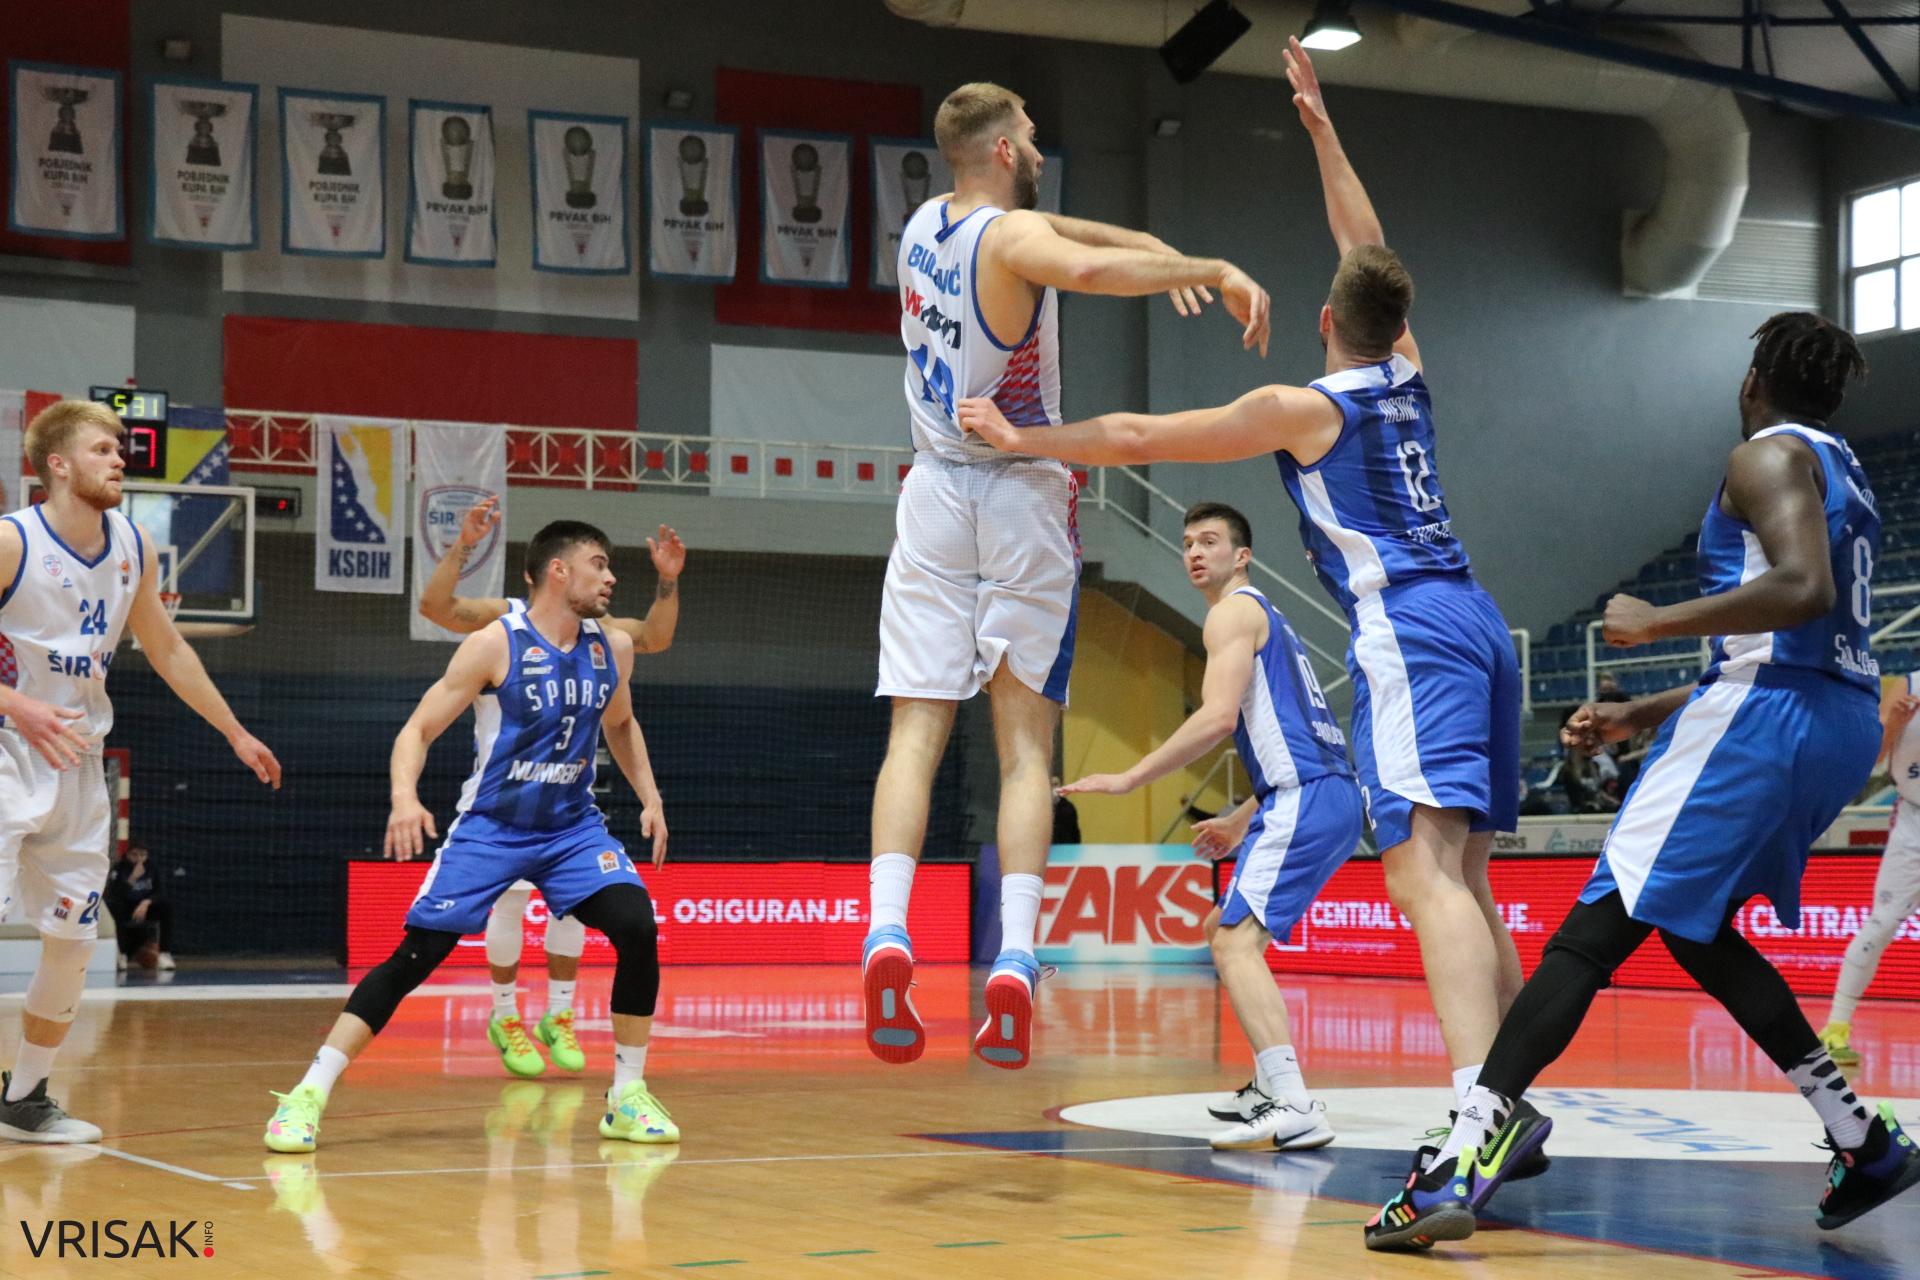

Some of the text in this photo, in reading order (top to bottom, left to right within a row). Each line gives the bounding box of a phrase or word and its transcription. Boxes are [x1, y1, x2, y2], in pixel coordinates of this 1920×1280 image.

[426, 201, 464, 214] PRVAK
[549, 211, 588, 222] PRVAK
[663, 218, 700, 230] PRVAK
[777, 225, 814, 237] PRVAK
[1396, 440, 1442, 512] 12
[329, 548, 392, 579] KSBIH
[1852, 536, 1873, 628] 8
[79, 599, 108, 635] 24
[525, 678, 611, 712] SPARS
[555, 716, 576, 751] 3
[673, 898, 861, 925] OSIGURANJE
[1310, 900, 1397, 930] CENTRAL
